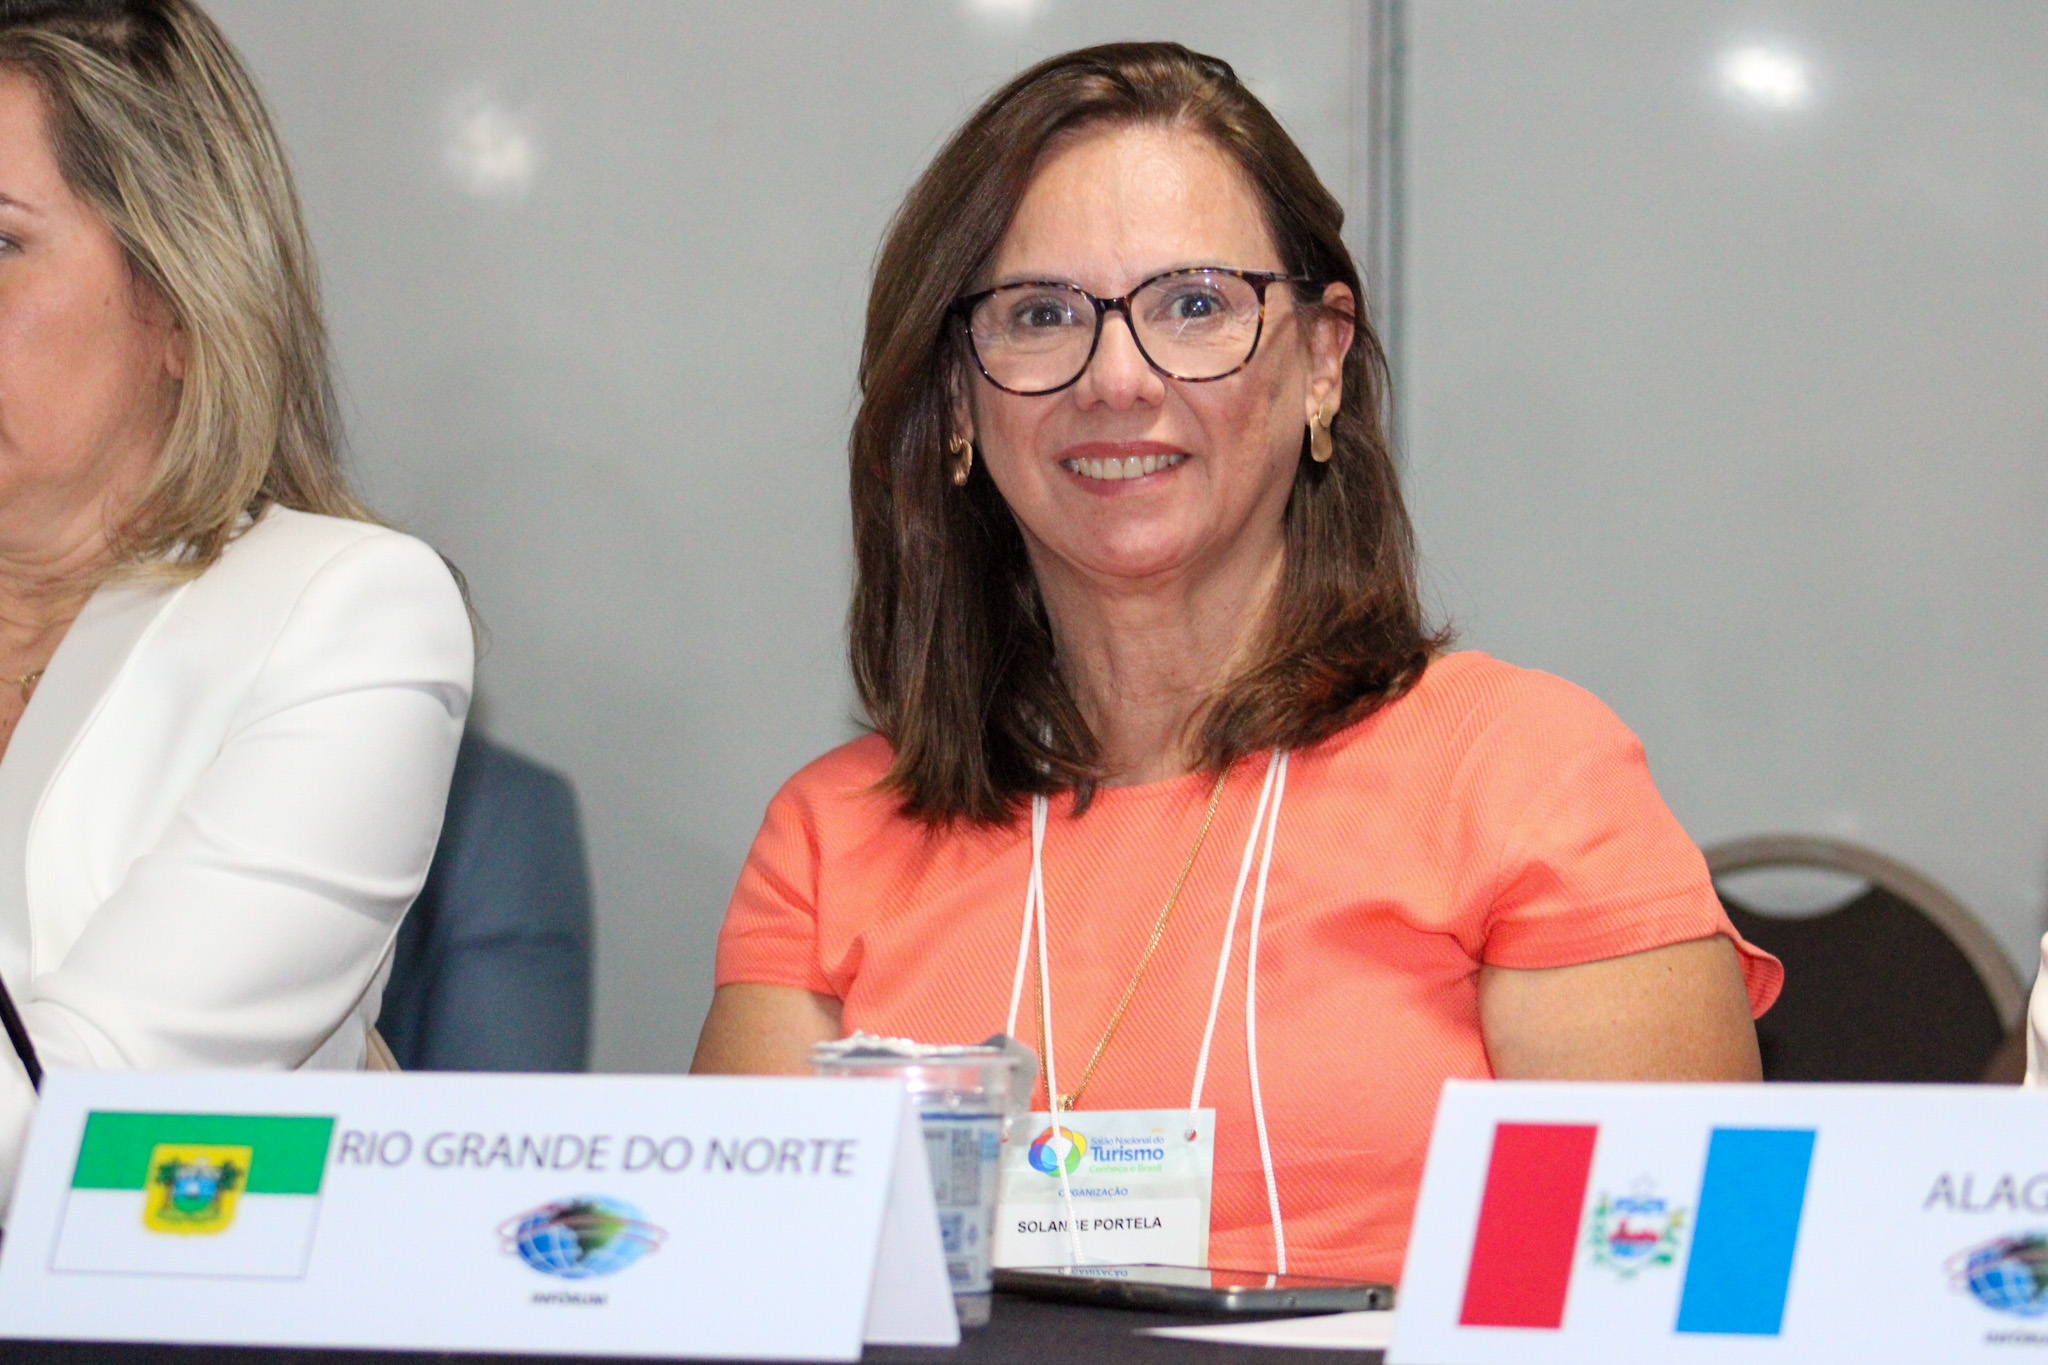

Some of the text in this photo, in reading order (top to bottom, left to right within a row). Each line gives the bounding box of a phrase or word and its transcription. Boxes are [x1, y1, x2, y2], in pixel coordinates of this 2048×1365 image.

[1090, 1135, 1165, 1146] Salão Nacional do
[337, 1129, 860, 1175] RIO GRANDE DO NORTE
[1090, 1145, 1165, 1162] Turismo
[1058, 1186, 1129, 1198] OGANIZAÇÃO
[1017, 1216, 1163, 1233] SOLANE PORTELA
